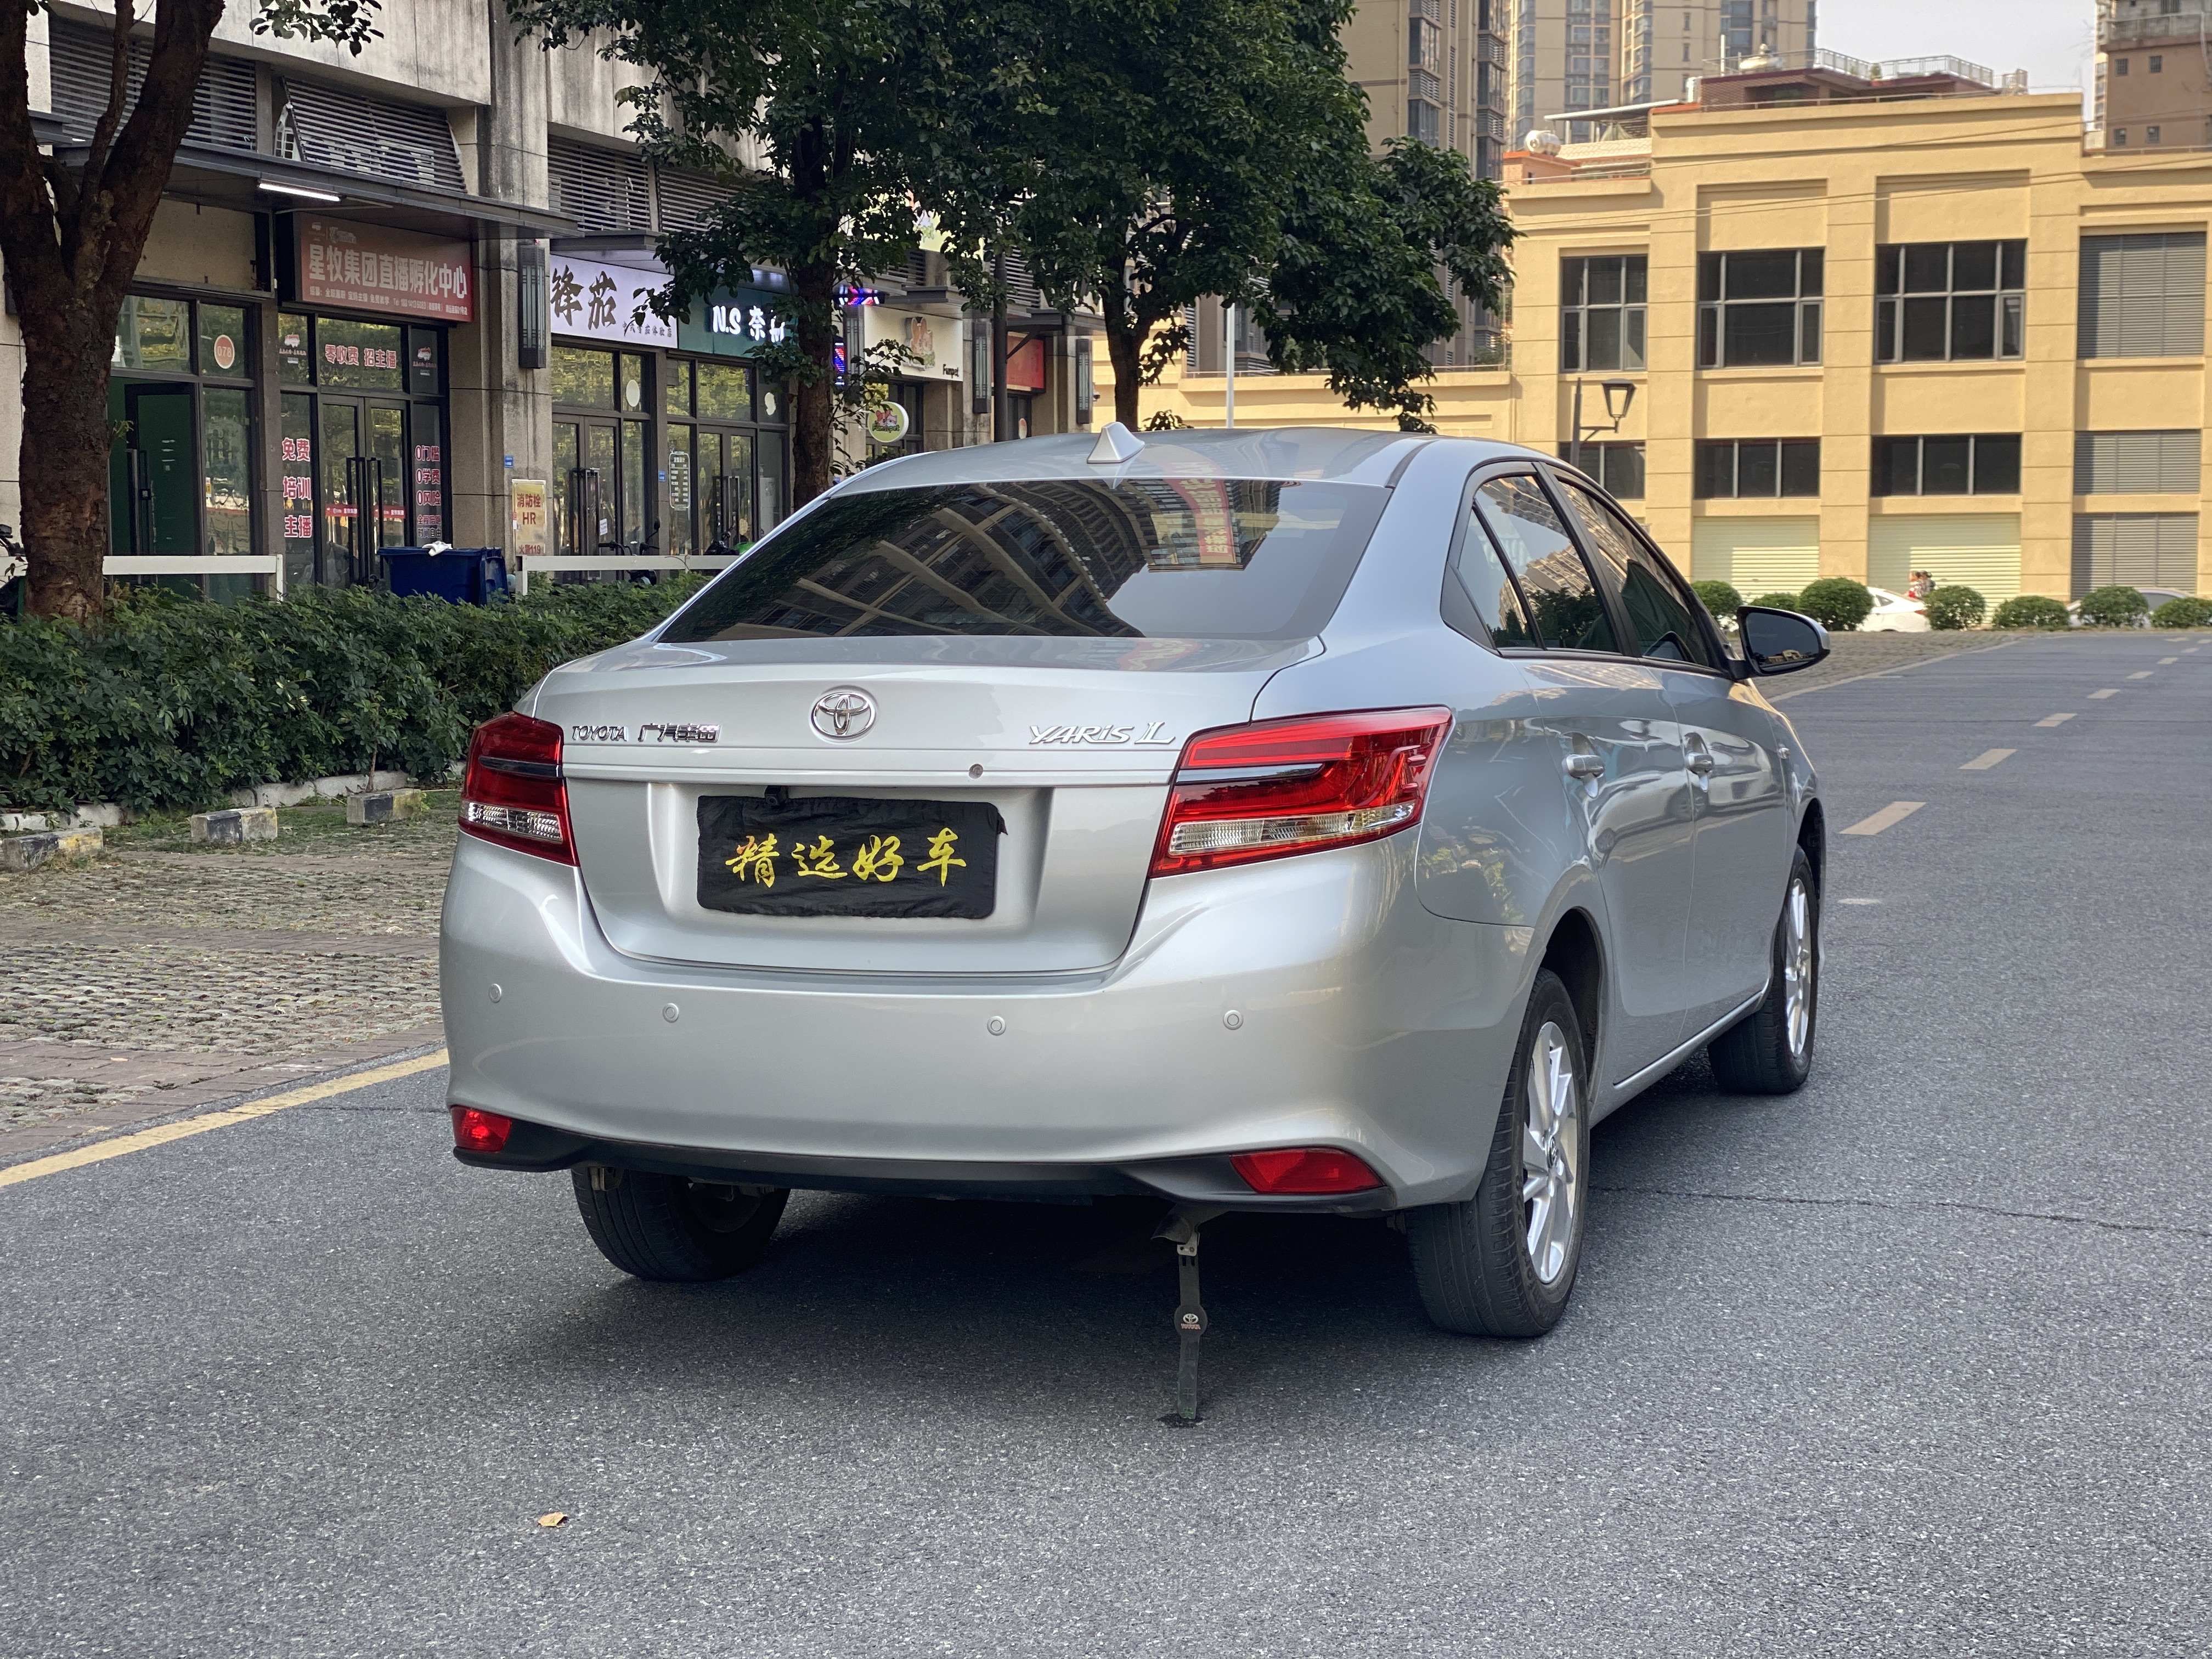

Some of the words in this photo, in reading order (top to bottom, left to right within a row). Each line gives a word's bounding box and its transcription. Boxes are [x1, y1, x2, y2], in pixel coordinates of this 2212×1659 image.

[309, 244, 467, 298] 星牧集团直播孵化中心
[217, 346, 232, 358] 078
[325, 344, 359, 366] 零收费
[363, 347, 397, 369] 招主播
[282, 437, 311, 462] 免费
[415, 445, 440, 461] 0门槛
[416, 468, 441, 484] 0学费
[283, 476, 312, 500] 培训
[417, 490, 441, 506] 0风险
[517, 493, 541, 507] 消防栓
[284, 515, 313, 538] 主播
[522, 512, 537, 525] HR
[518, 544, 541, 555] 火警119
[572, 725, 628, 742] TOYOTA
[1134, 721, 1176, 744] L
[725, 827, 967, 888] 精选好车
